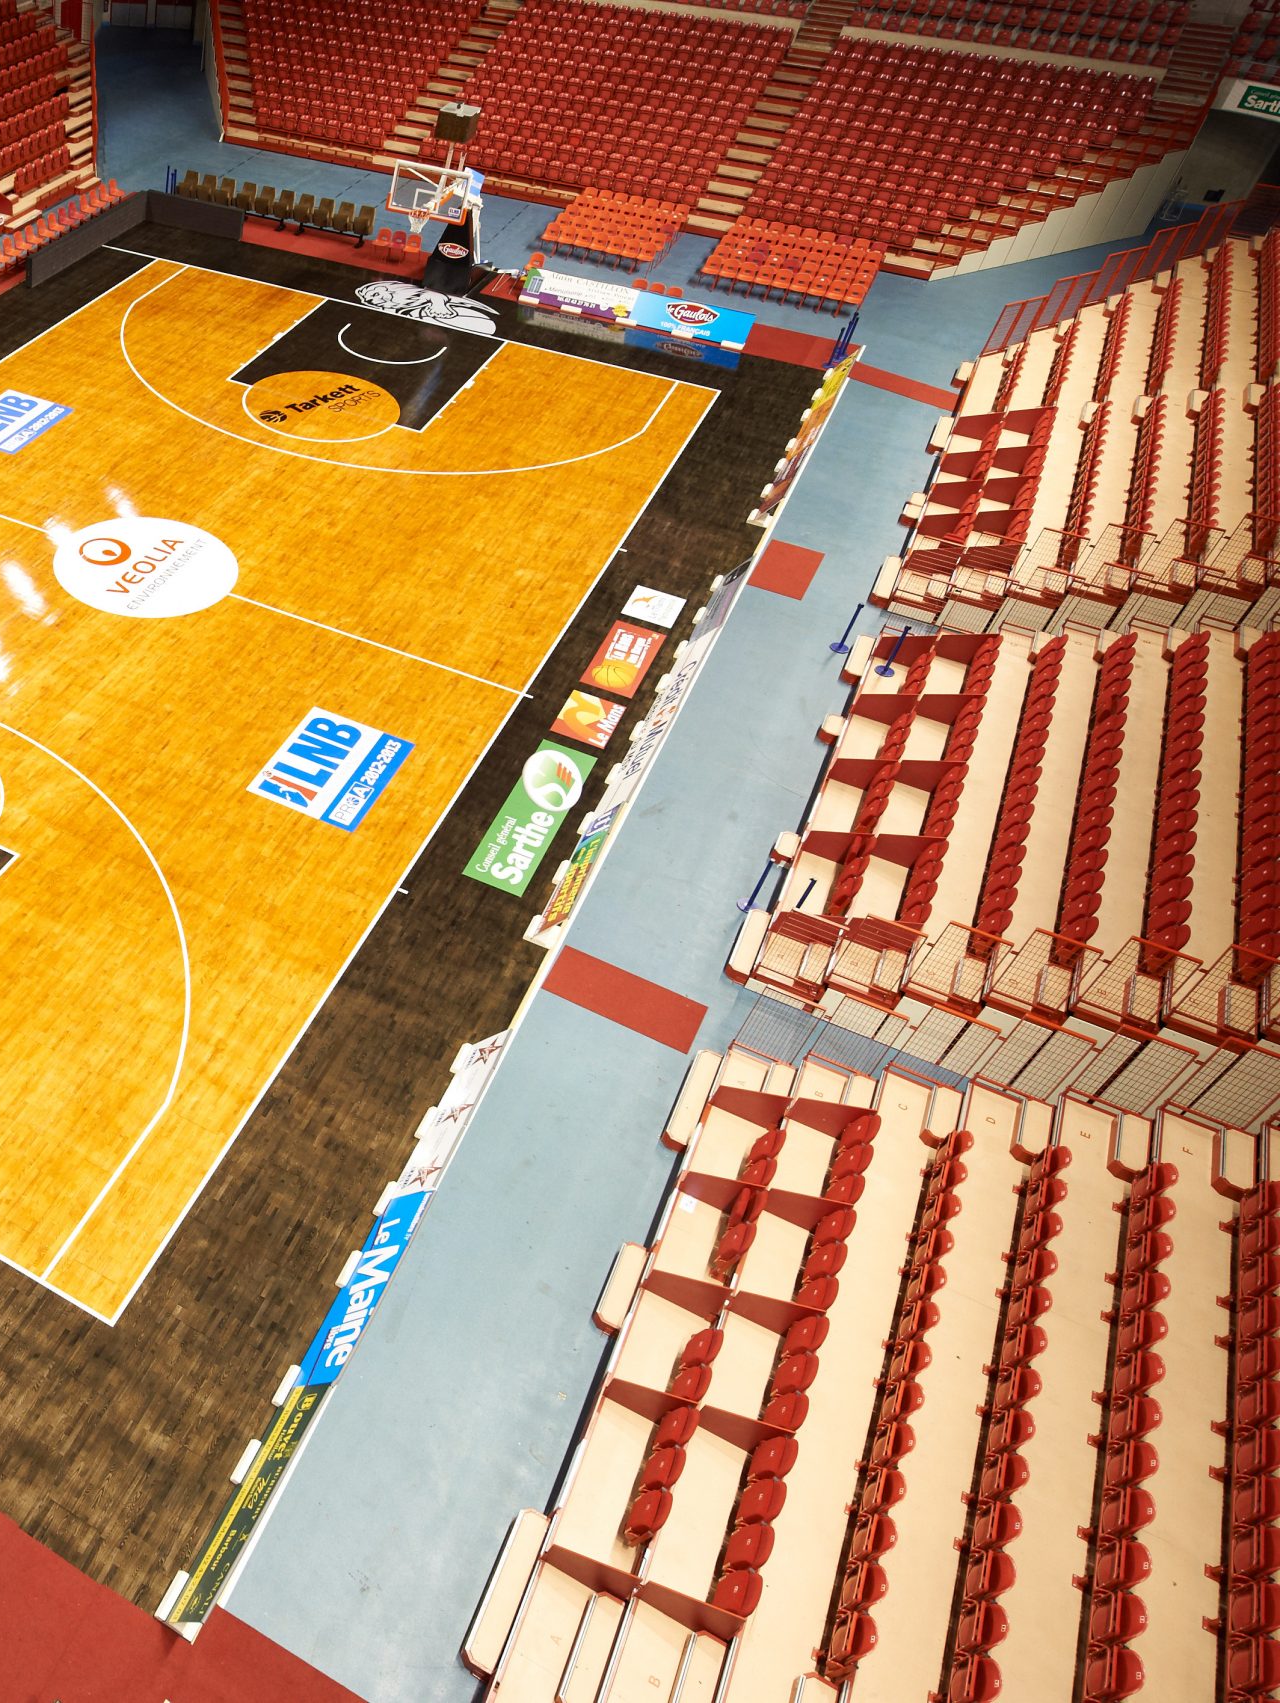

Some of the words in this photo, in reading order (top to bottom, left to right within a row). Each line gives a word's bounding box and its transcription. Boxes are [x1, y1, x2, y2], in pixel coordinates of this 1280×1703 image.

[674, 303, 714, 323] Gaulois
[285, 384, 360, 413] Tarkett
[328, 390, 381, 413] SPORTS
[106, 539, 184, 594] VEOLIA
[126, 538, 207, 610] ENVIRONNEMENT
[660, 660, 698, 709] Crédit
[589, 732, 606, 748] Le
[597, 704, 626, 734] Mans
[273, 717, 362, 788] LNB
[360, 739, 402, 785] 2012-2013
[622, 721, 668, 780] Mutuel
[475, 843, 501, 873] Conseil
[496, 815, 517, 845] général
[490, 811, 554, 885] Sarthe
[374, 1218, 400, 1246] Le
[325, 1244, 400, 1368] Maine
[273, 1394, 317, 1460] Bouvet
[252, 1466, 282, 1521] BURBERRY
[211, 1529, 237, 1572] Barbour
[199, 1562, 230, 1615] CANALI
[648, 1675, 662, 1689] B
